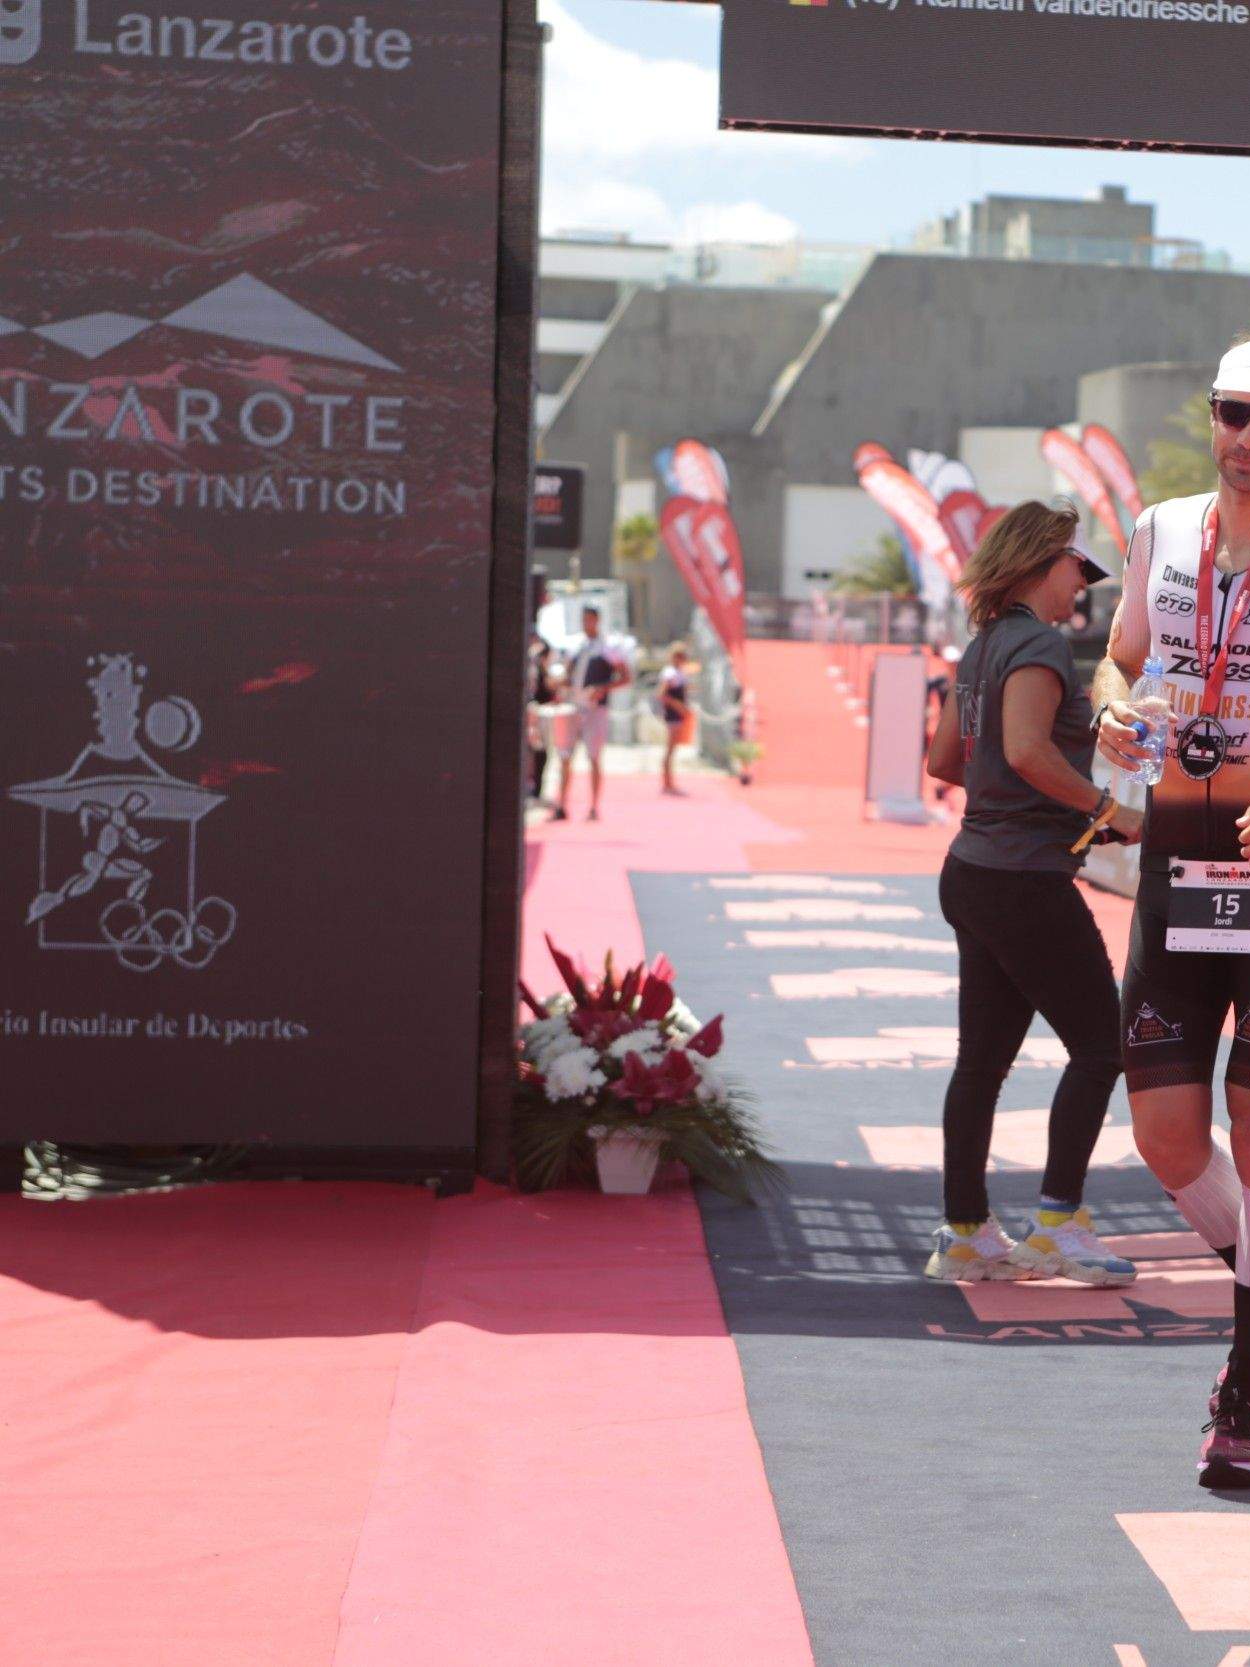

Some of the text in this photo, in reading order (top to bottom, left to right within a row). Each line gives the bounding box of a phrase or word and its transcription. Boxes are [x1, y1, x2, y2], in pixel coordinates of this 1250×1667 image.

[74, 0, 412, 70] Lanzarote
[67, 468, 408, 515] DESTINATION
[1156, 593, 1194, 613] PTO
[1211, 893, 1241, 915] 15
[1214, 917, 1233, 926] Jordi
[37, 1008, 140, 1036] Insular
[145, 1012, 179, 1038] de
[186, 1012, 309, 1045] Deportes
